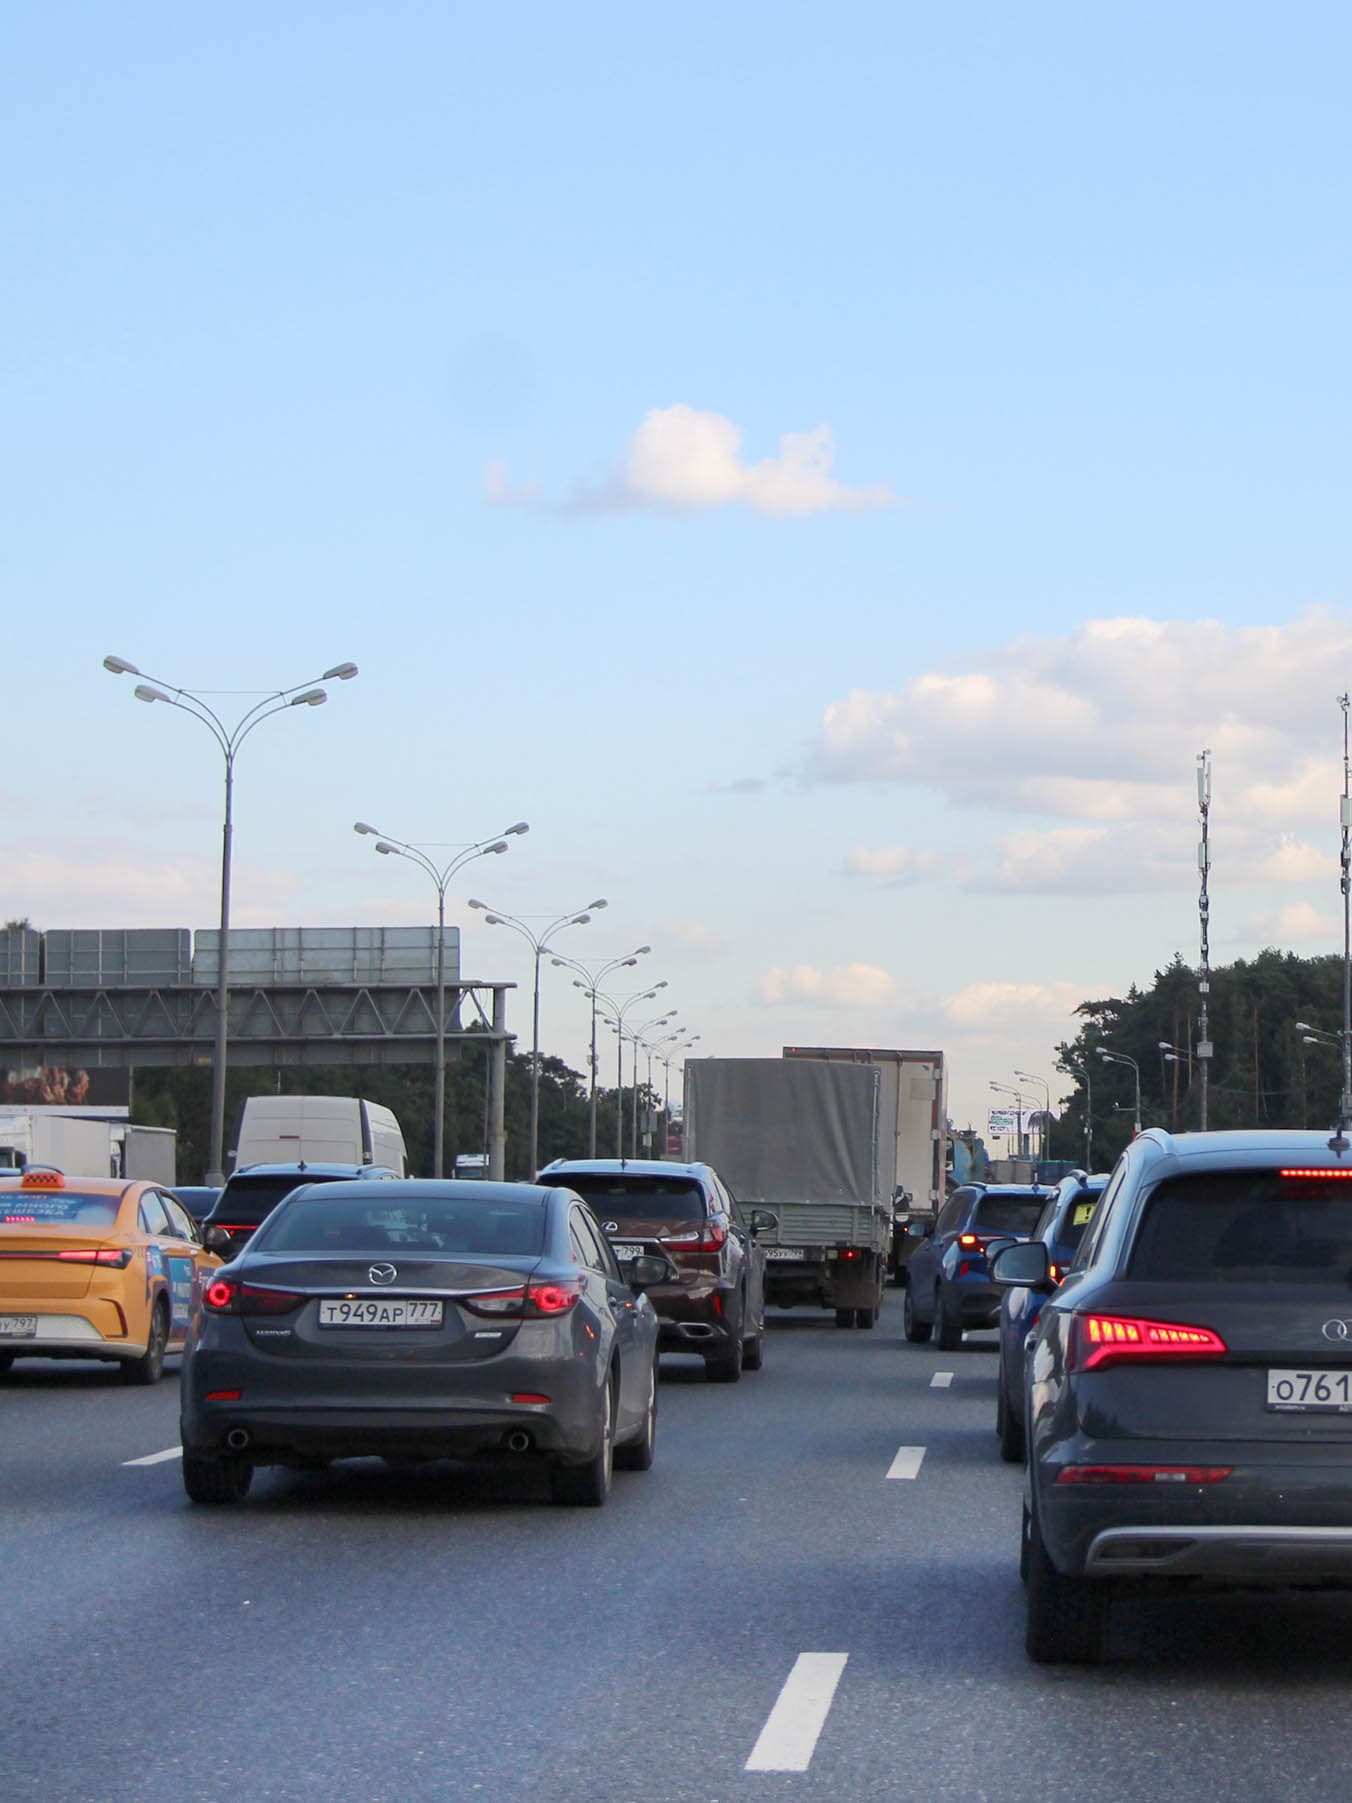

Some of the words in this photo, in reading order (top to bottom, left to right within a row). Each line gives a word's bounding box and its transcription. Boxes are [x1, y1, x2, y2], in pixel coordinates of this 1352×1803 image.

[623, 1246, 641, 1256] 799
[327, 1303, 404, 1323] Т949АР
[409, 1302, 438, 1318] 777
[13, 1318, 33, 1330] 797
